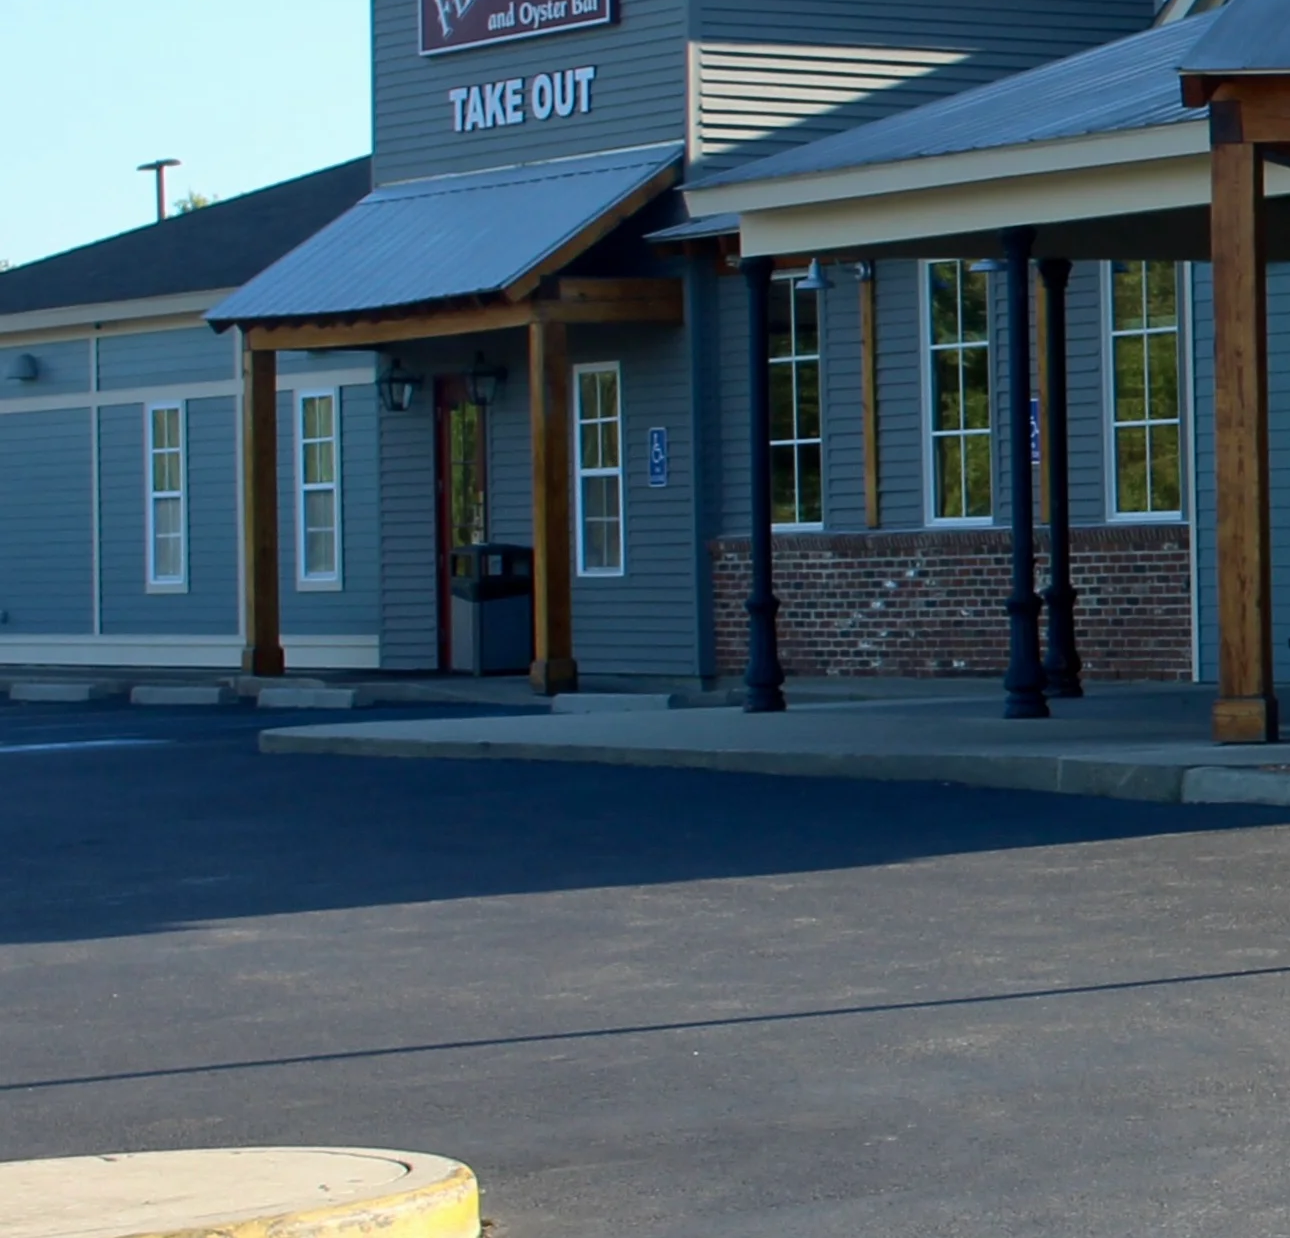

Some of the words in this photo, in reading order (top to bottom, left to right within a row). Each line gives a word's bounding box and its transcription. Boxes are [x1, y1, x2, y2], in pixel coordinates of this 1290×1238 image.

[487, 1, 515, 31] and
[519, 1, 566, 28] Oyster
[449, 77, 524, 132] TAKE
[531, 67, 596, 120] OUT
